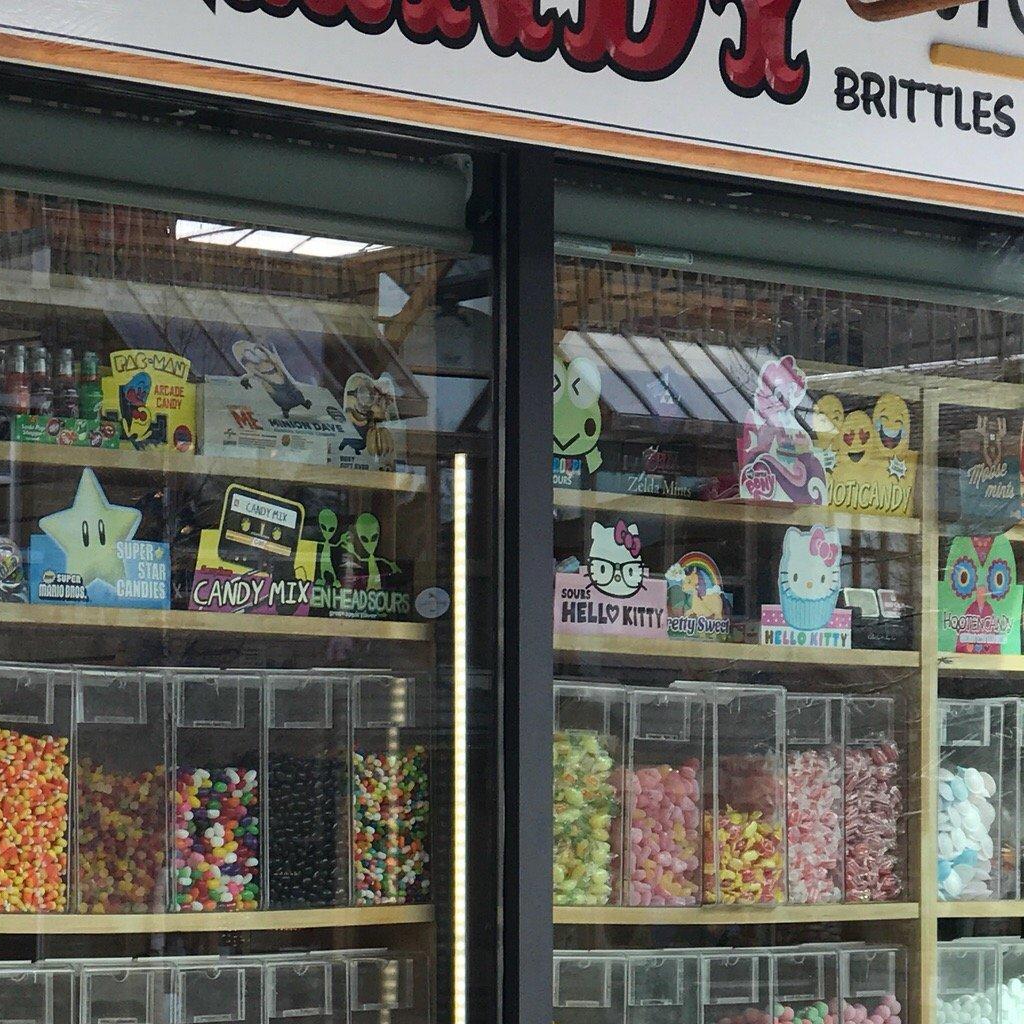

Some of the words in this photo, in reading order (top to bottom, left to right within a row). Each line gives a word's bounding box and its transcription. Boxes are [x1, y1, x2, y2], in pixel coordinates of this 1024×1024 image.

[834, 66, 1016, 138] BRITTLES
[153, 384, 185, 398] ARCADE
[156, 397, 182, 410] CANDY
[268, 418, 312, 431] MINION
[313, 422, 345, 433] DAVE
[553, 475, 573, 486] OURS
[626, 471, 660, 494] Zelda
[662, 479, 692, 498] Mints
[984, 481, 1015, 499] mints
[245, 501, 272, 519] CANDY
[272, 509, 288, 523] MIX
[116, 541, 154, 561] SUPER
[56, 573, 82, 583] SUPER
[138, 561, 167, 581] STAR
[38, 583, 64, 598] MARIO
[65, 584, 88, 600] BROS.
[116, 579, 166, 600] CANDIES
[193, 579, 263, 606] CANDY
[268, 580, 311, 606] MIX
[311, 586, 330, 609] EN
[330, 588, 368, 612] HEAD
[561, 588, 591, 600] SOURS
[622, 605, 664, 628] KITTY
[667, 616, 696, 636] retty
[696, 616, 730, 634] Sweet
[765, 629, 807, 646] HELLO
[809, 631, 847, 648] KITTY
